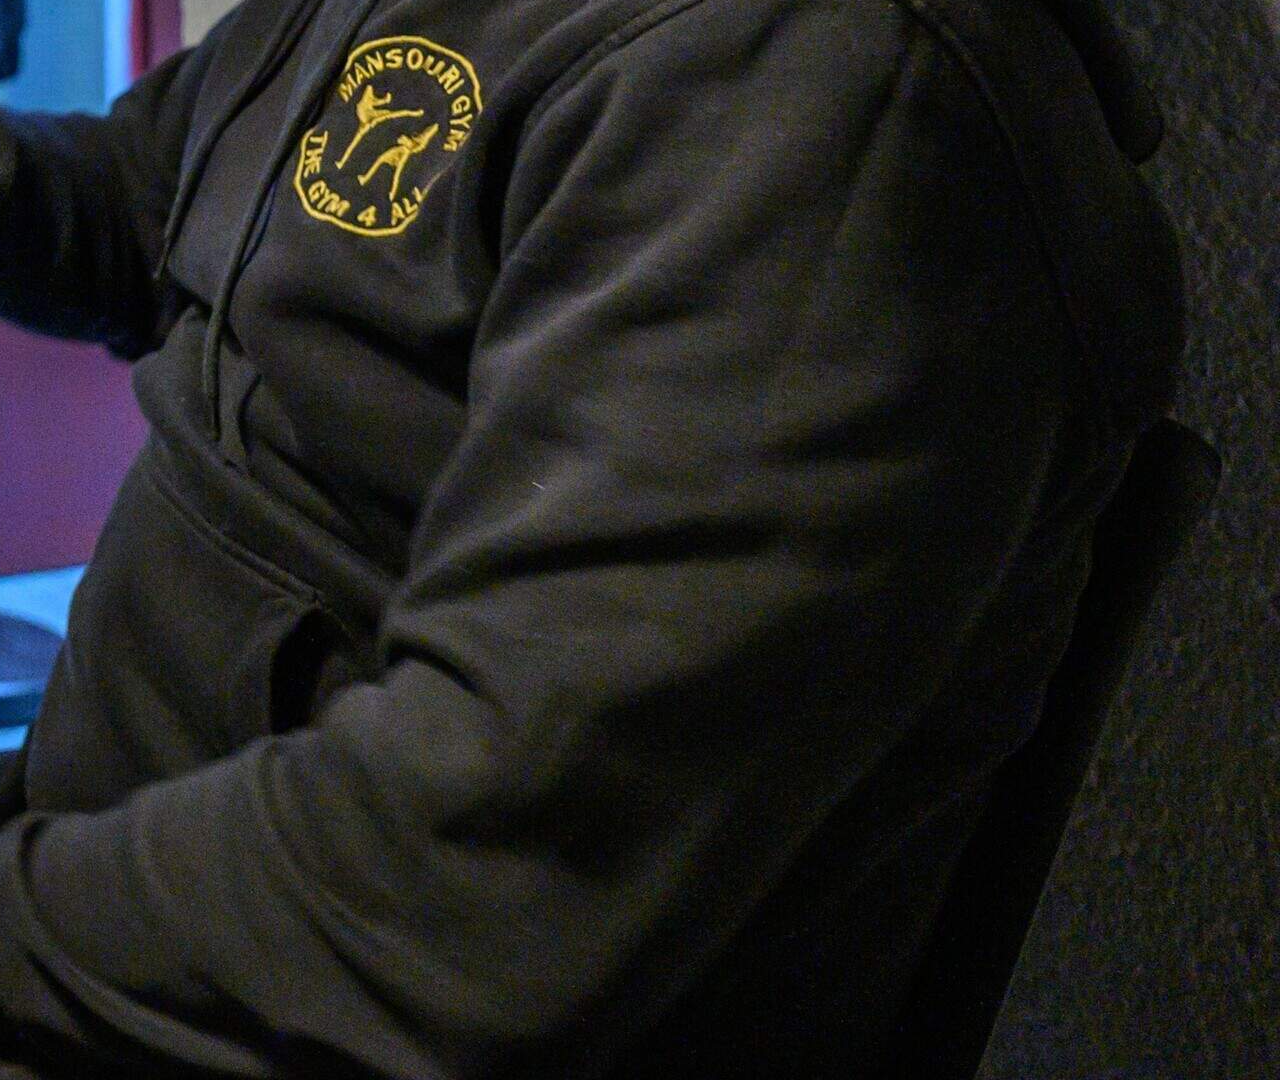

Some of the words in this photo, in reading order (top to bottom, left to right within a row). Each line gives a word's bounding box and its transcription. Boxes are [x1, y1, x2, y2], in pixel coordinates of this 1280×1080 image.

[339, 47, 465, 103] MANSOURI
[443, 95, 473, 152] GYM
[303, 130, 329, 178] THE
[357, 205, 377, 227] 4
